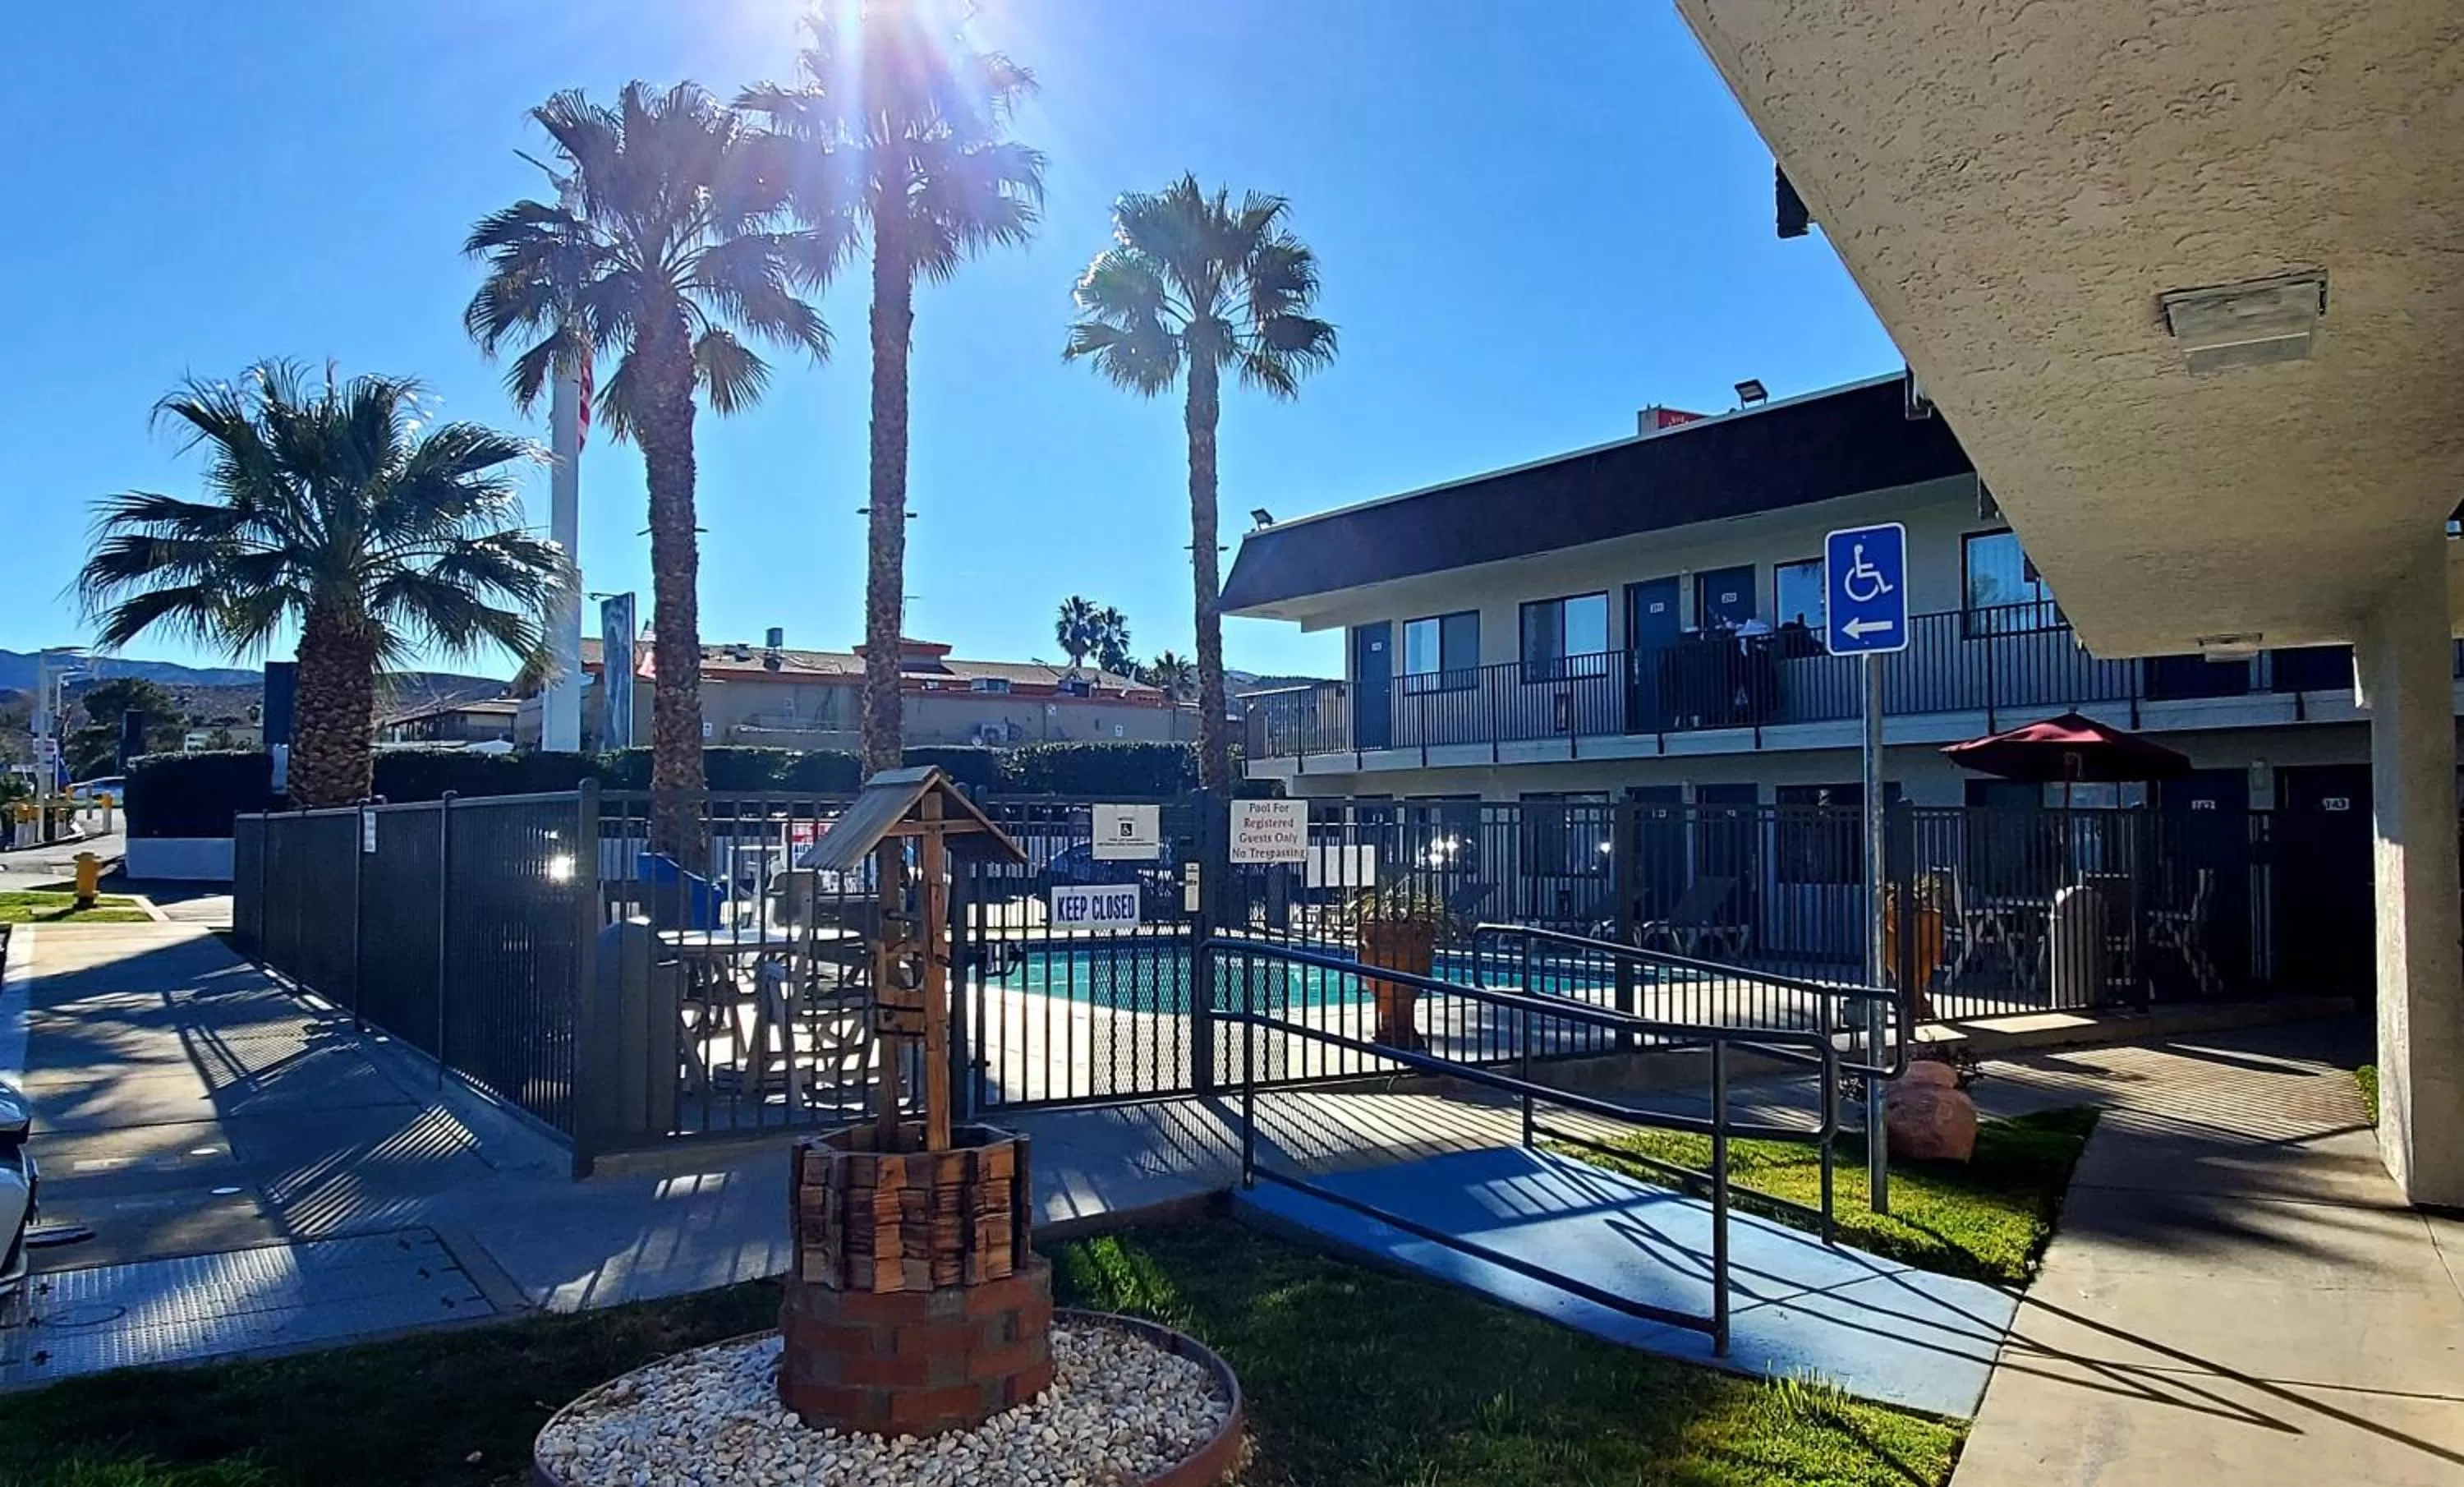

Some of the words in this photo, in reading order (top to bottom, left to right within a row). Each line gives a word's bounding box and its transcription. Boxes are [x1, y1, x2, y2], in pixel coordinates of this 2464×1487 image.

[1249, 803, 1271, 813] Pool
[1273, 803, 1289, 813] For
[1243, 817, 1294, 830] Registered
[1239, 832, 1272, 843] Guests
[1275, 832, 1298, 844] Only
[1232, 847, 1246, 859] No
[1250, 847, 1305, 860] Trespassing
[1057, 895, 1088, 922] KEEP
[1092, 894, 1135, 920] CLOSED
